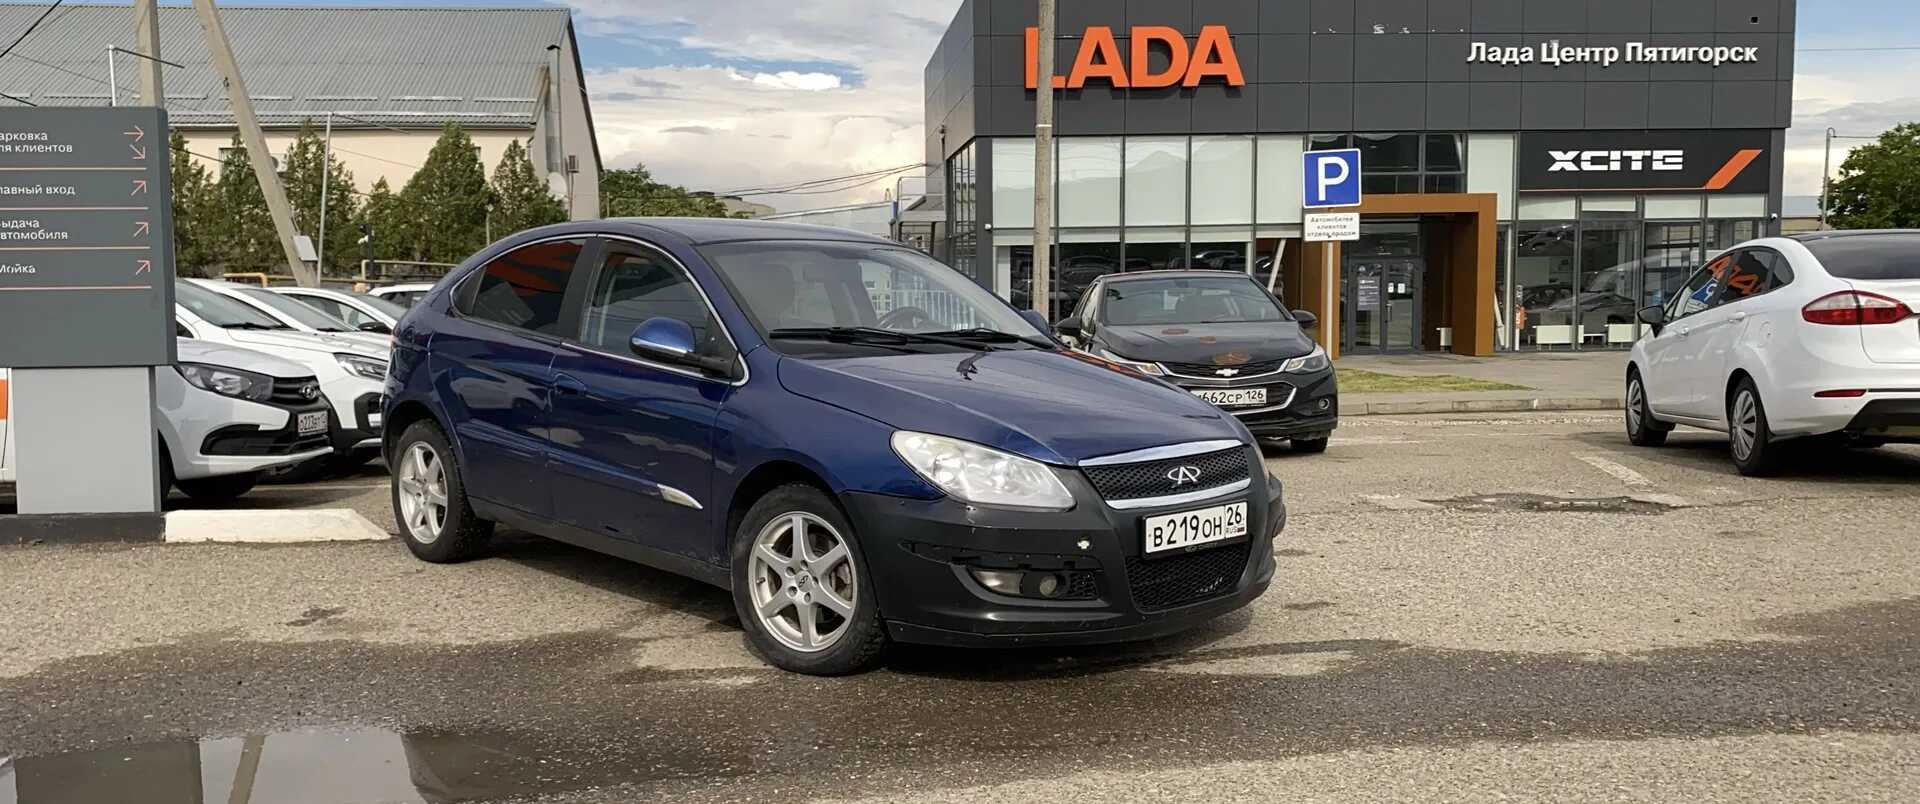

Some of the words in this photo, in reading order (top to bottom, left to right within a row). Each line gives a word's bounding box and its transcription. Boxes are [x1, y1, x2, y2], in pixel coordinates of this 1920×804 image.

[1025, 25, 1245, 88] LADA
[1467, 42, 1534, 65] Лада
[1541, 41, 1619, 66] Центр
[1625, 42, 1758, 66] Пятигорск
[15, 144, 73, 152] клиентов
[1548, 149, 1683, 171] XCITE
[1318, 156, 1350, 201] P
[46, 186, 75, 195] вход
[0, 219, 40, 229] ыдача
[1199, 391, 1243, 404] 662СР
[1245, 390, 1264, 400] 126
[1226, 505, 1243, 527] 26
